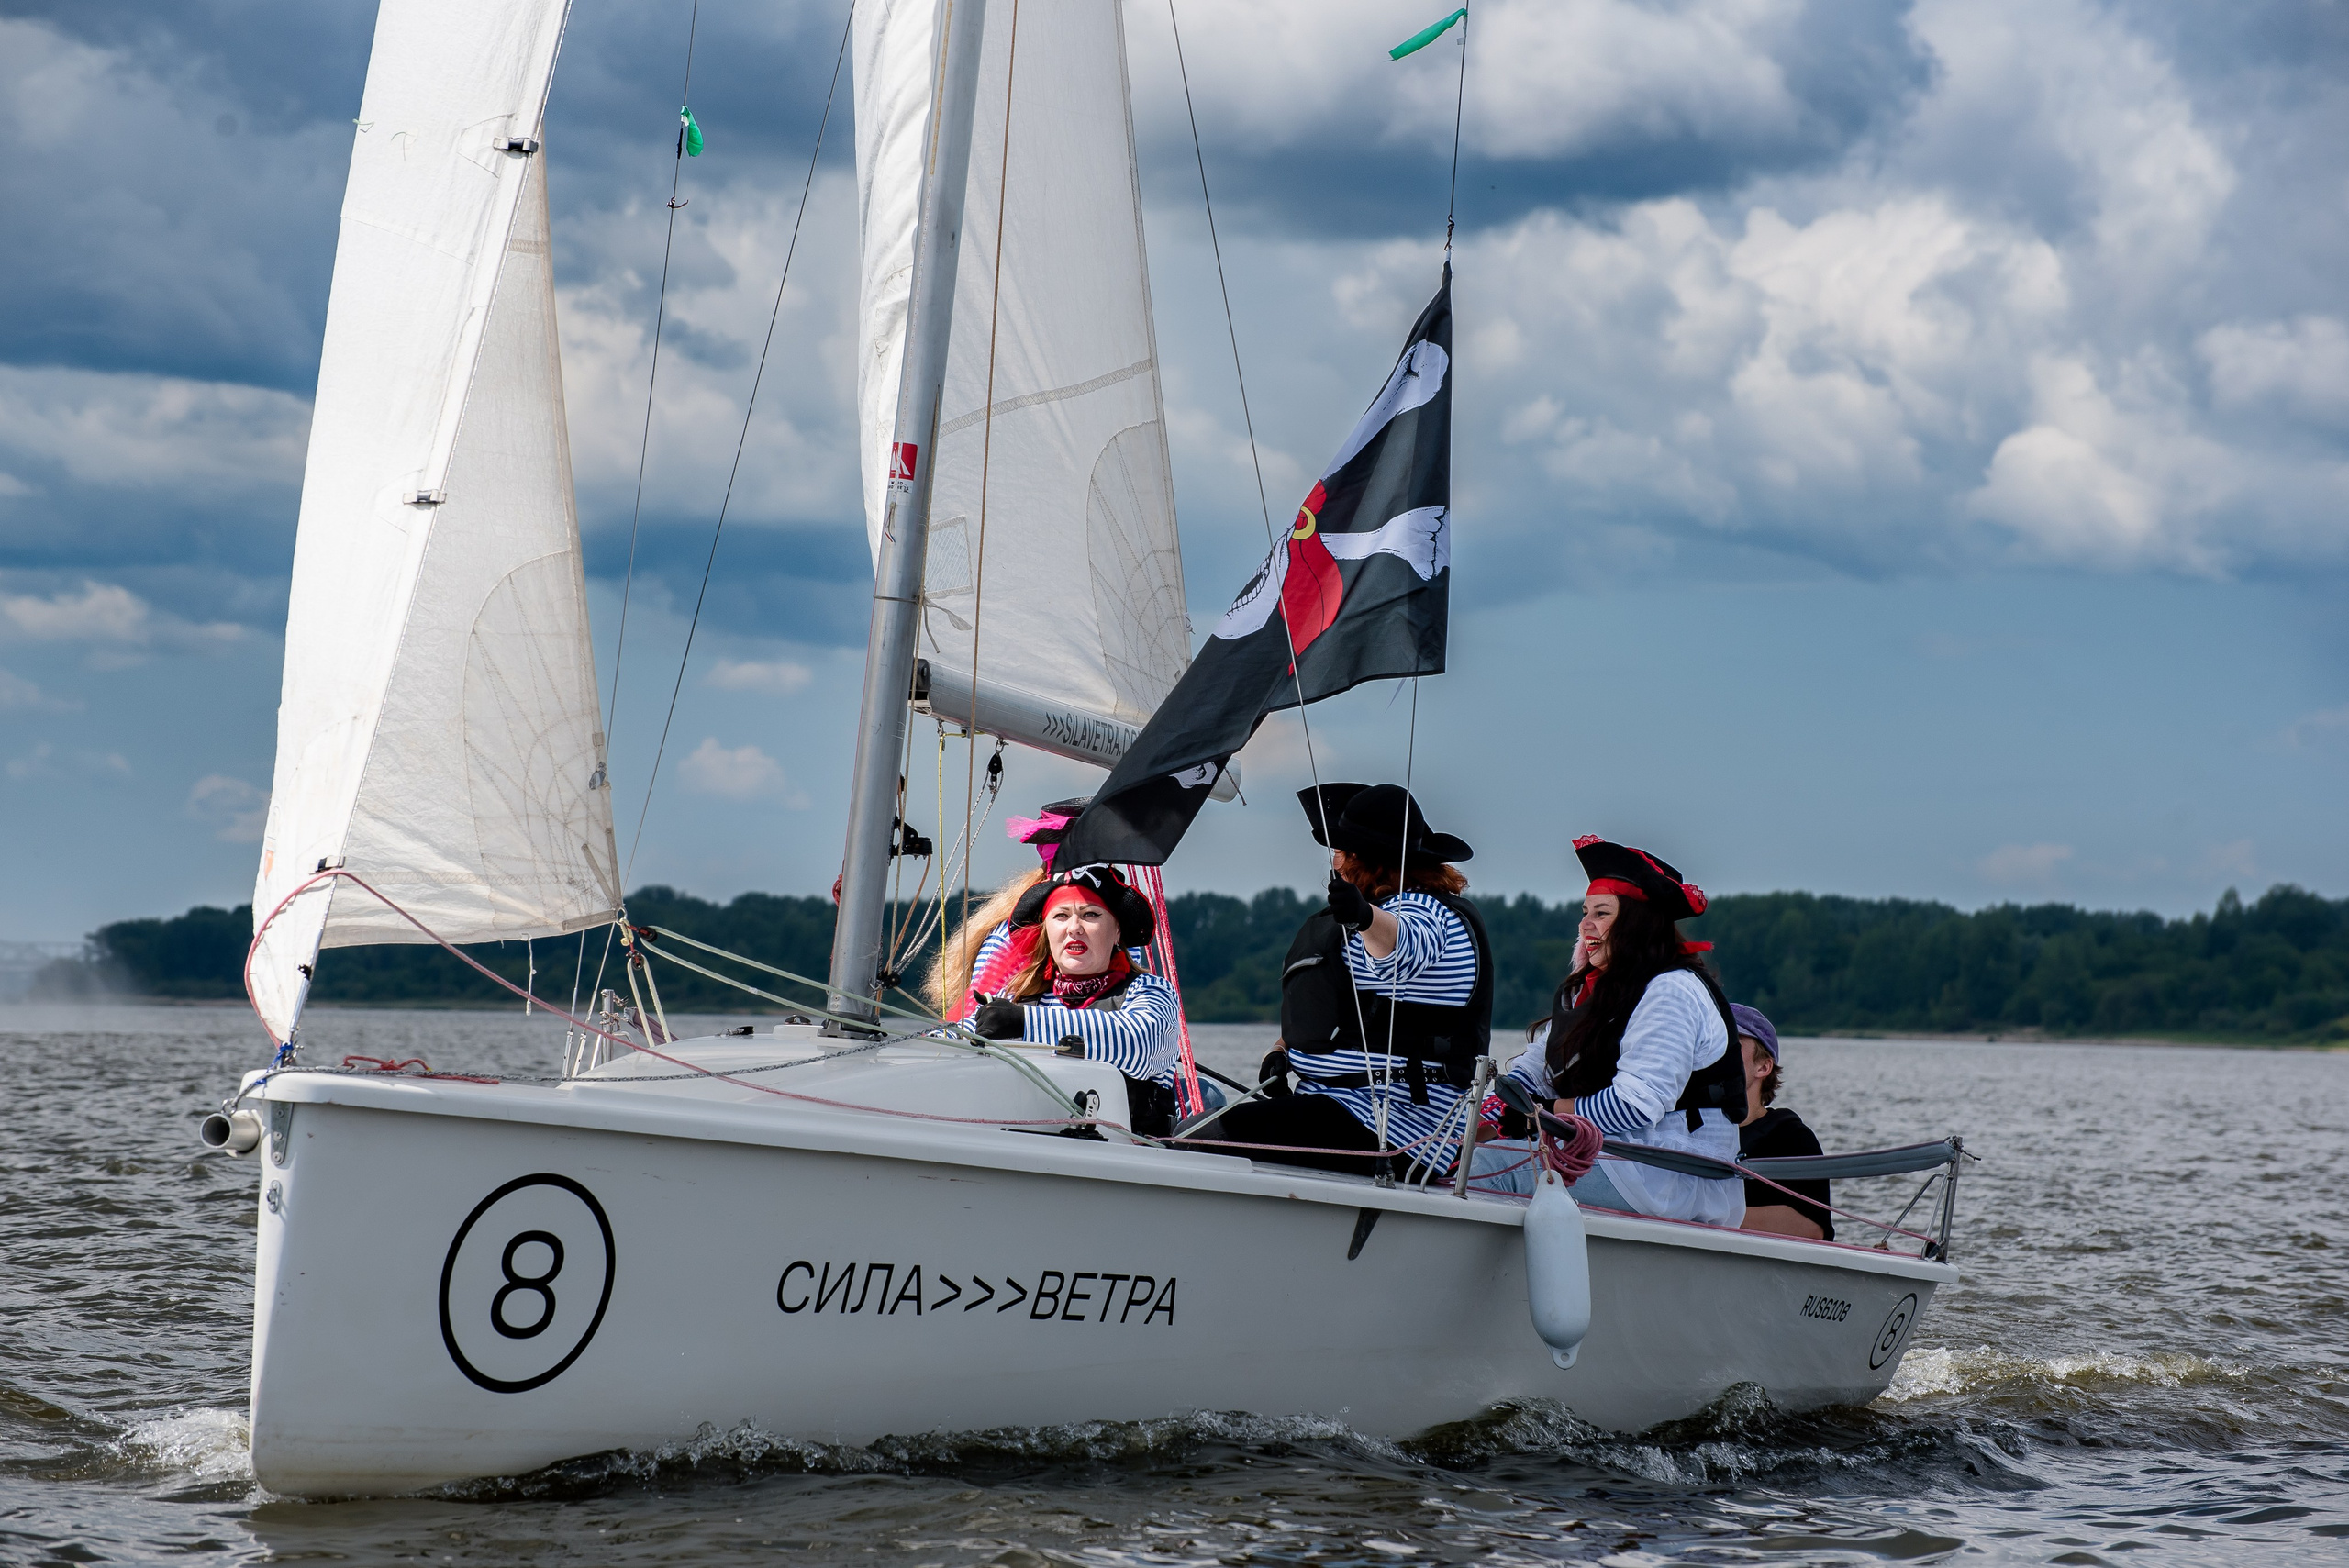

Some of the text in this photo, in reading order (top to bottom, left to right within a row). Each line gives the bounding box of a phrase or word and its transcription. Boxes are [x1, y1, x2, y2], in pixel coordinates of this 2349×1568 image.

[490, 1229, 565, 1340] 8
[1799, 1294, 1852, 1322] RUS6108
[1881, 1313, 1905, 1351] 8
